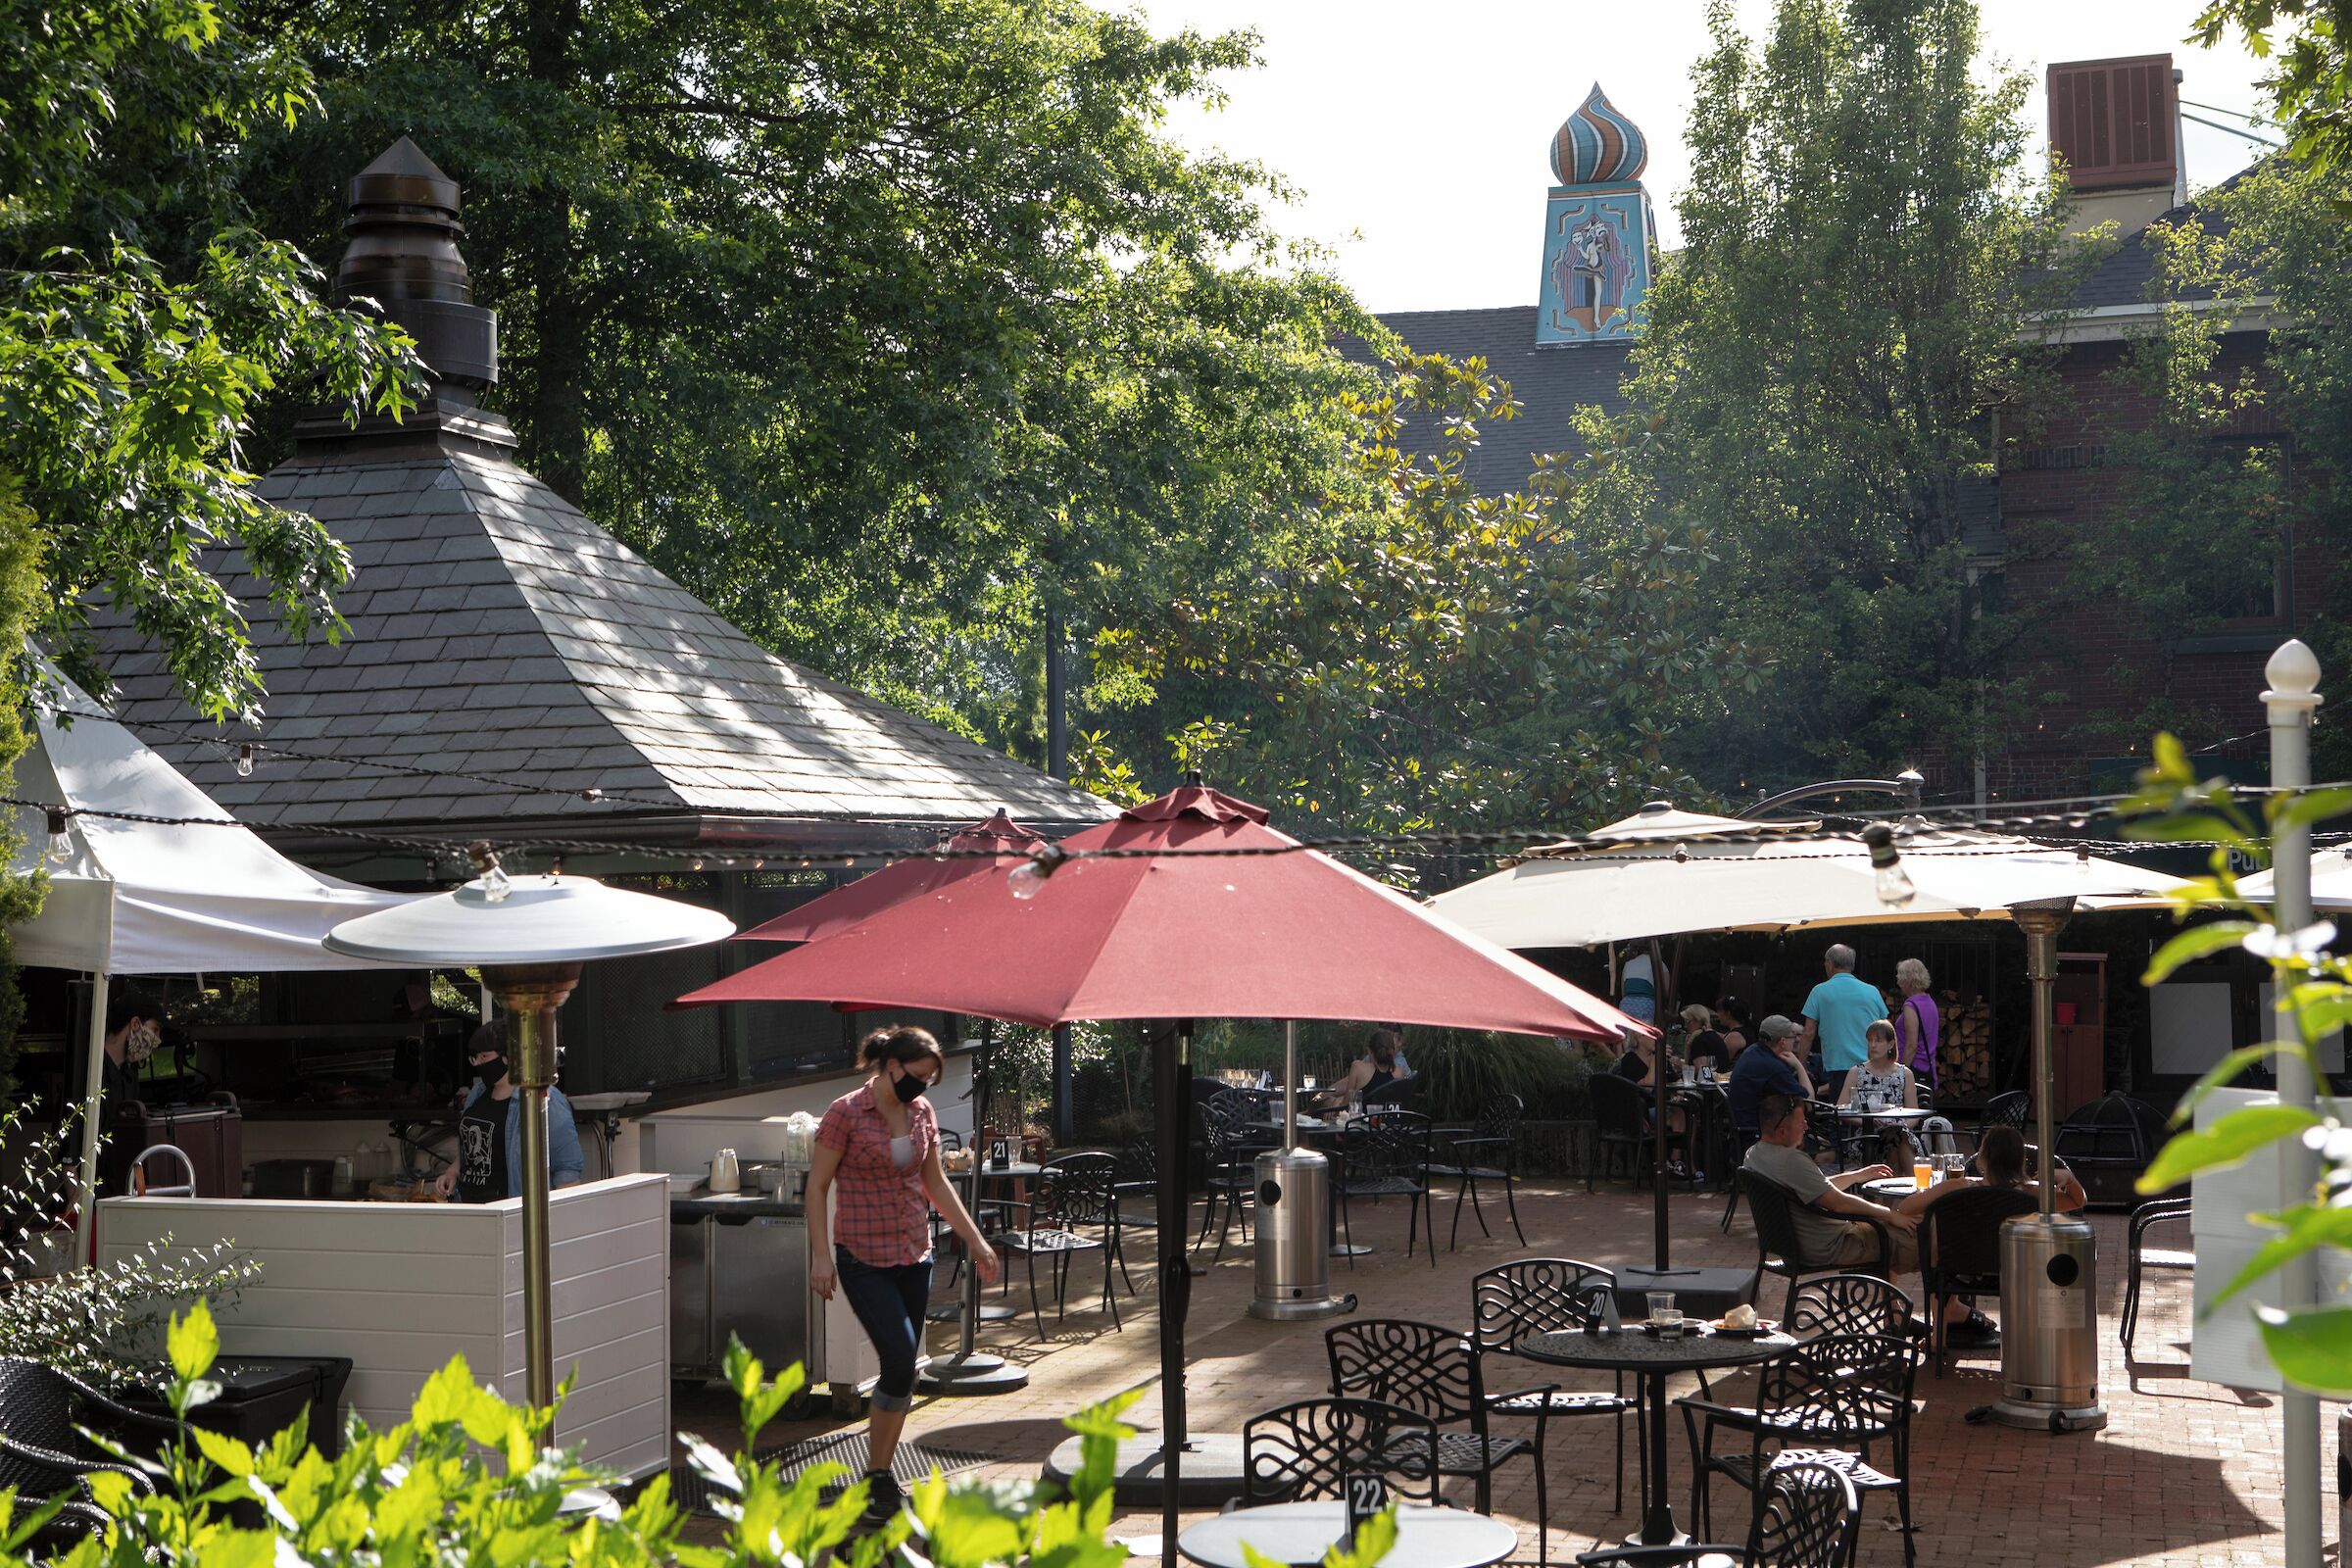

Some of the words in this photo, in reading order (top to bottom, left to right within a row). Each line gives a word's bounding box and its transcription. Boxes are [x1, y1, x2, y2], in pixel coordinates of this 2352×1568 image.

[994, 1142, 1006, 1158] 21
[1589, 1292, 1605, 1316] 20
[1353, 1478, 1383, 1514] 22
